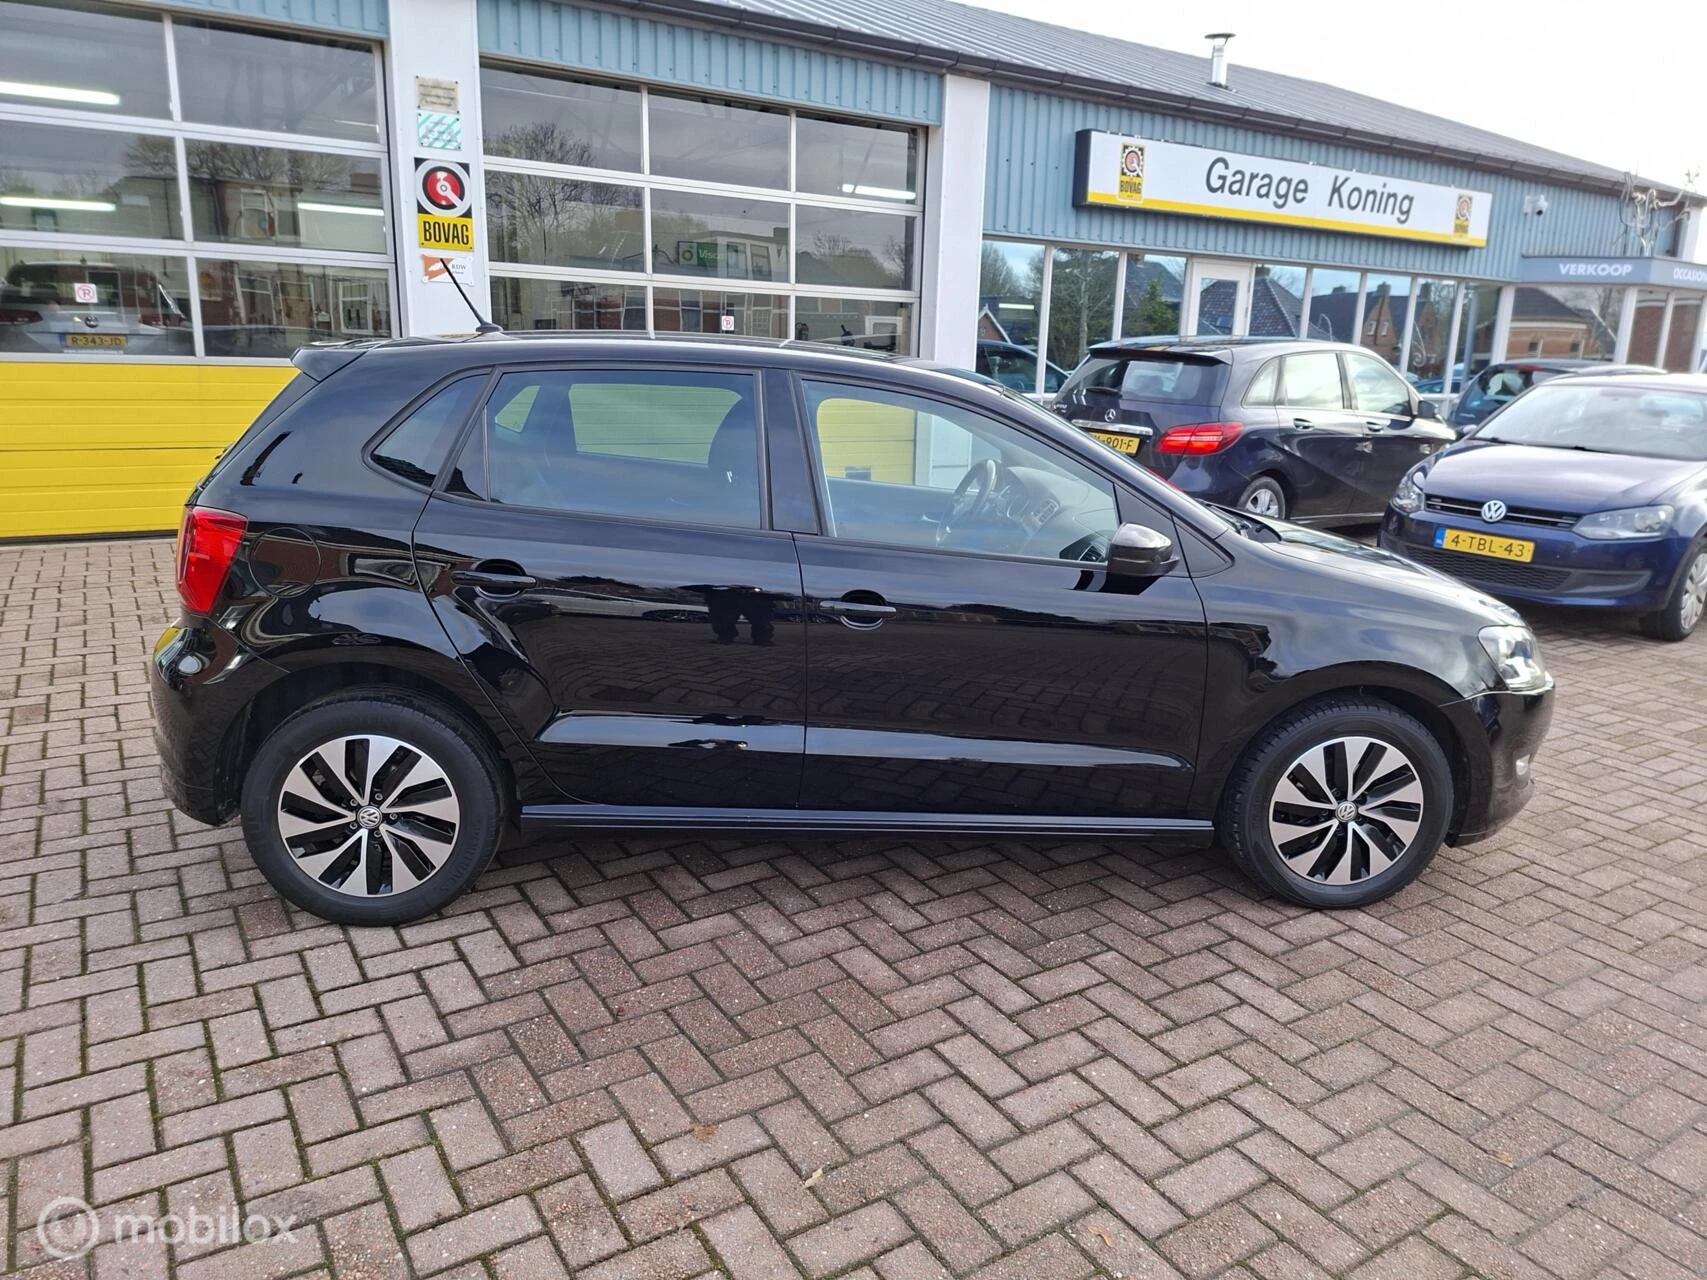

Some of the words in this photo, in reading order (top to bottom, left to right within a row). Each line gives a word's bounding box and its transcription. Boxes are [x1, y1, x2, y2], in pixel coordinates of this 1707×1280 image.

[1205, 156, 1309, 209] Garage
[1327, 174, 1415, 225] Koning
[423, 220, 470, 246] BOVAG
[1559, 262, 1633, 277] VERKOOP
[71, 336, 123, 346] R-343-JD
[1451, 534, 1525, 558] 4-TBL-43
